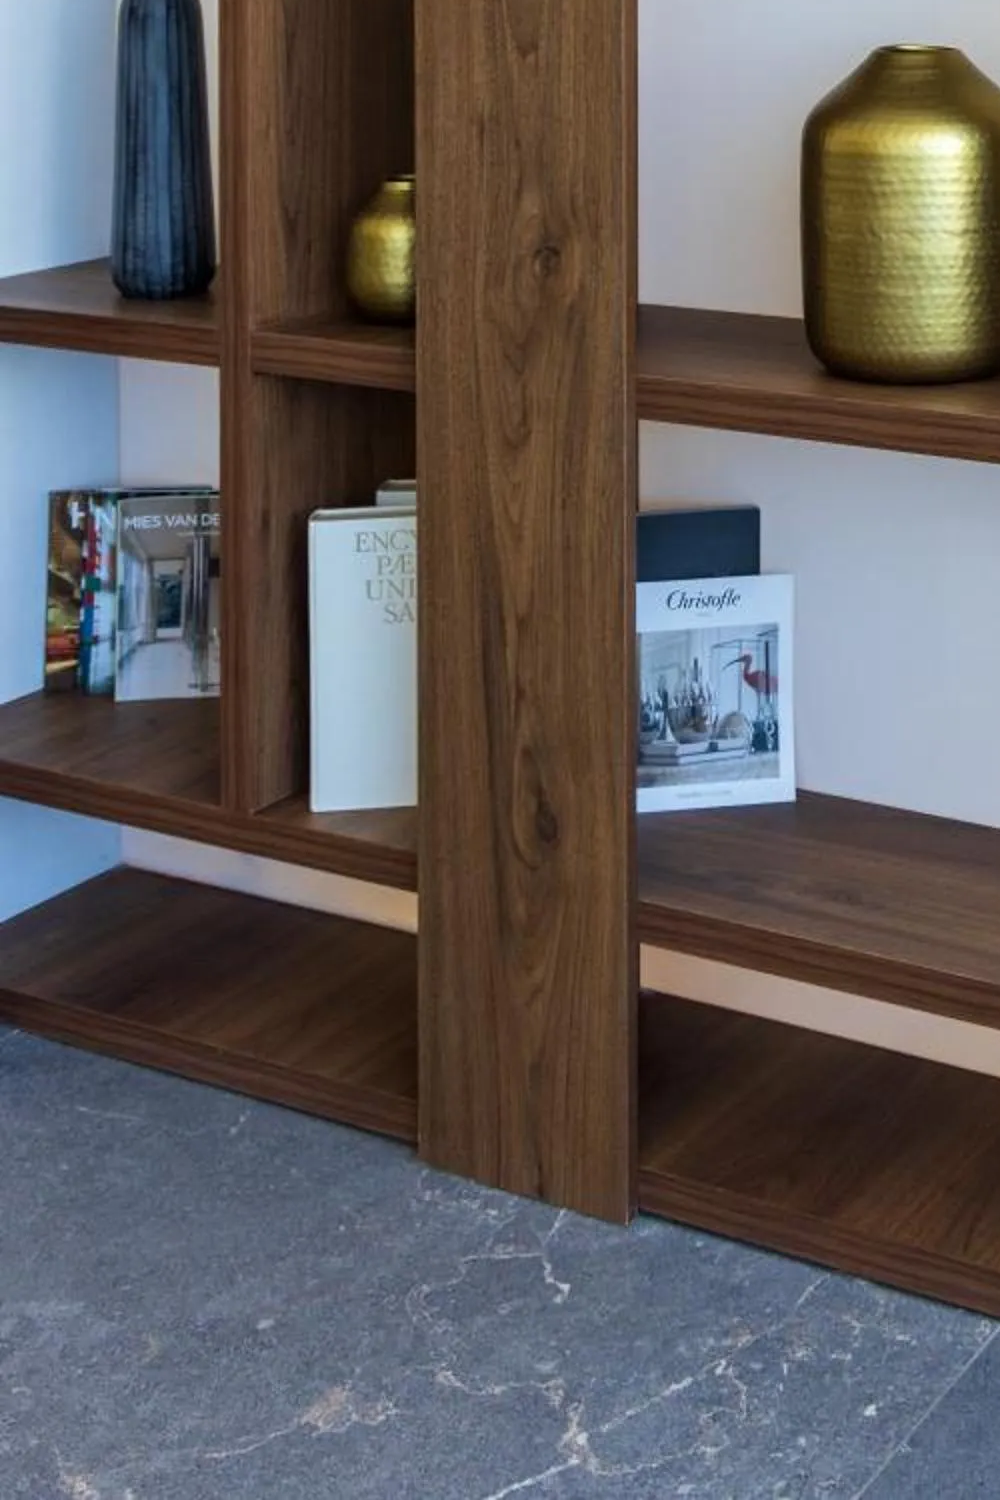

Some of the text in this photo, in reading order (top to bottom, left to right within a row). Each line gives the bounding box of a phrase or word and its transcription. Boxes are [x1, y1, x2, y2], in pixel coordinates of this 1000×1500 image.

[123, 514, 161, 531] MIES
[164, 513, 196, 529] VAN
[666, 587, 742, 611] Christofle
[383, 600, 415, 624] SA
